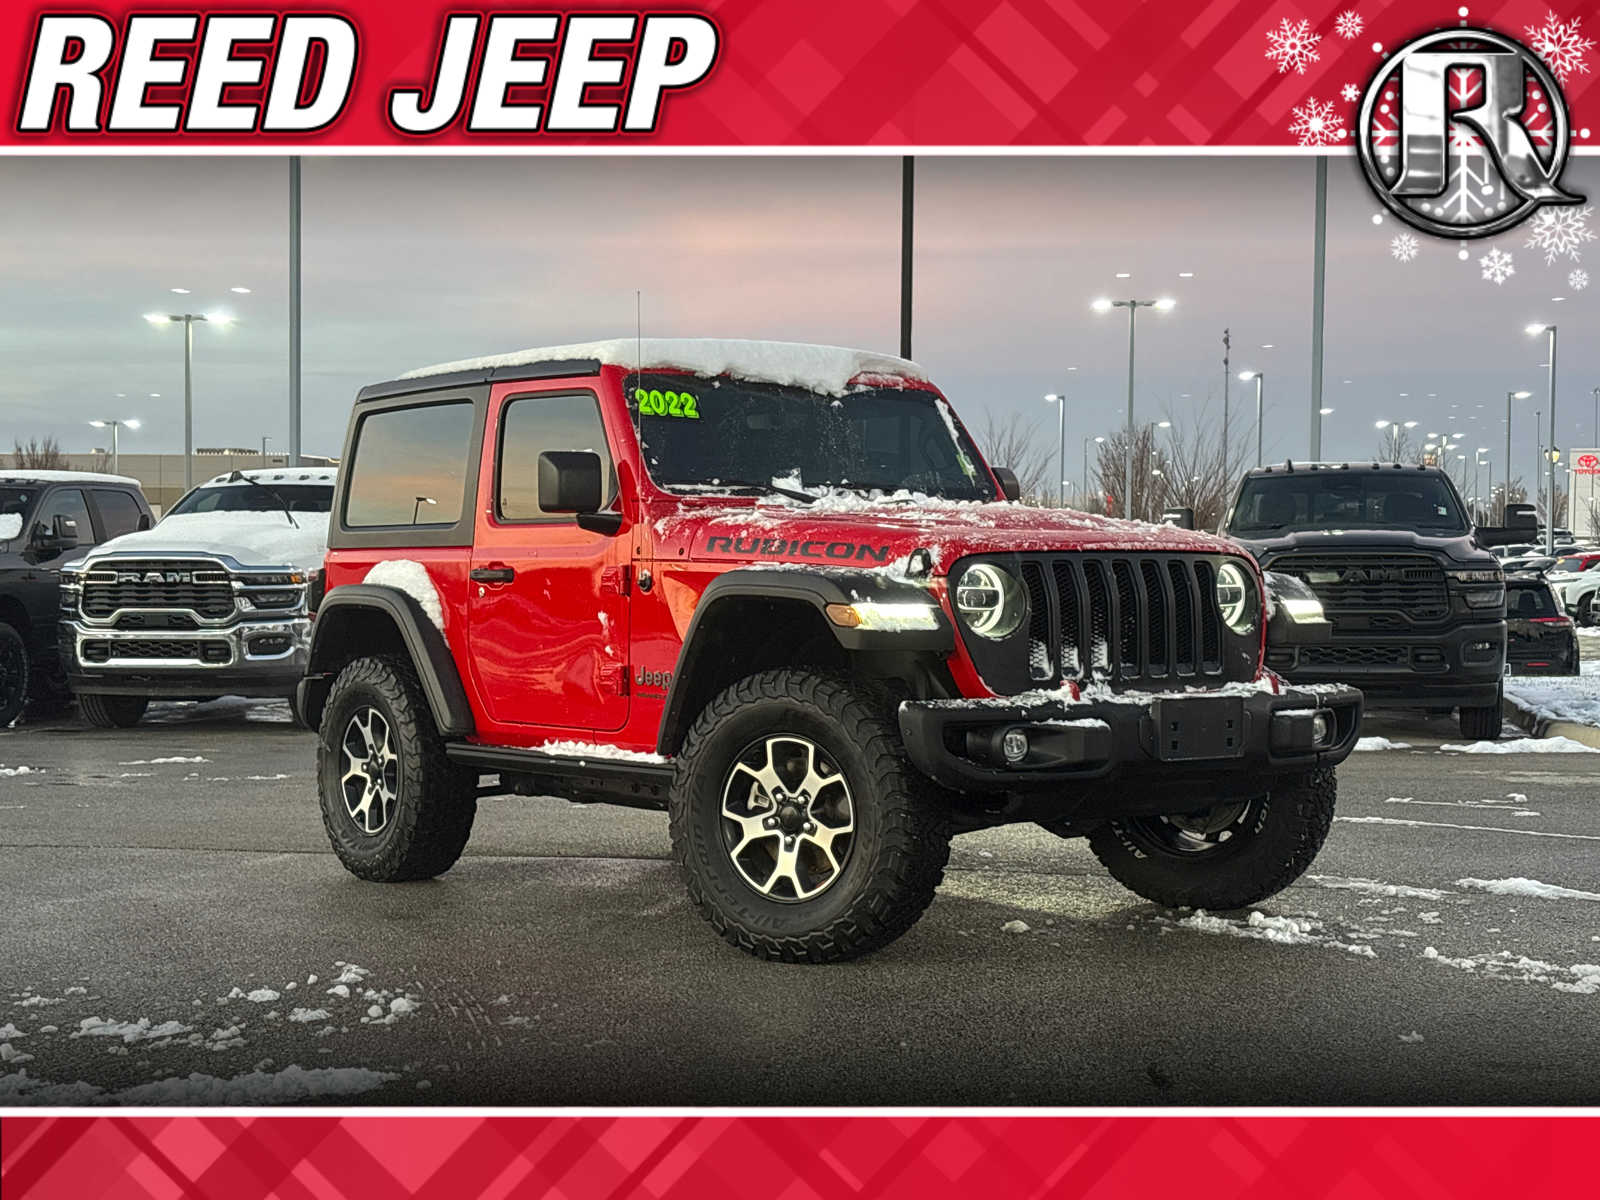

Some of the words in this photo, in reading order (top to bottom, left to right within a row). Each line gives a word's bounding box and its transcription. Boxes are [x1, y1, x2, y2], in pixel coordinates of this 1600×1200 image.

[635, 388, 700, 419] 2022
[706, 535, 891, 563] RUBICON
[119, 571, 191, 584] RAM
[635, 665, 673, 691] Jeep
